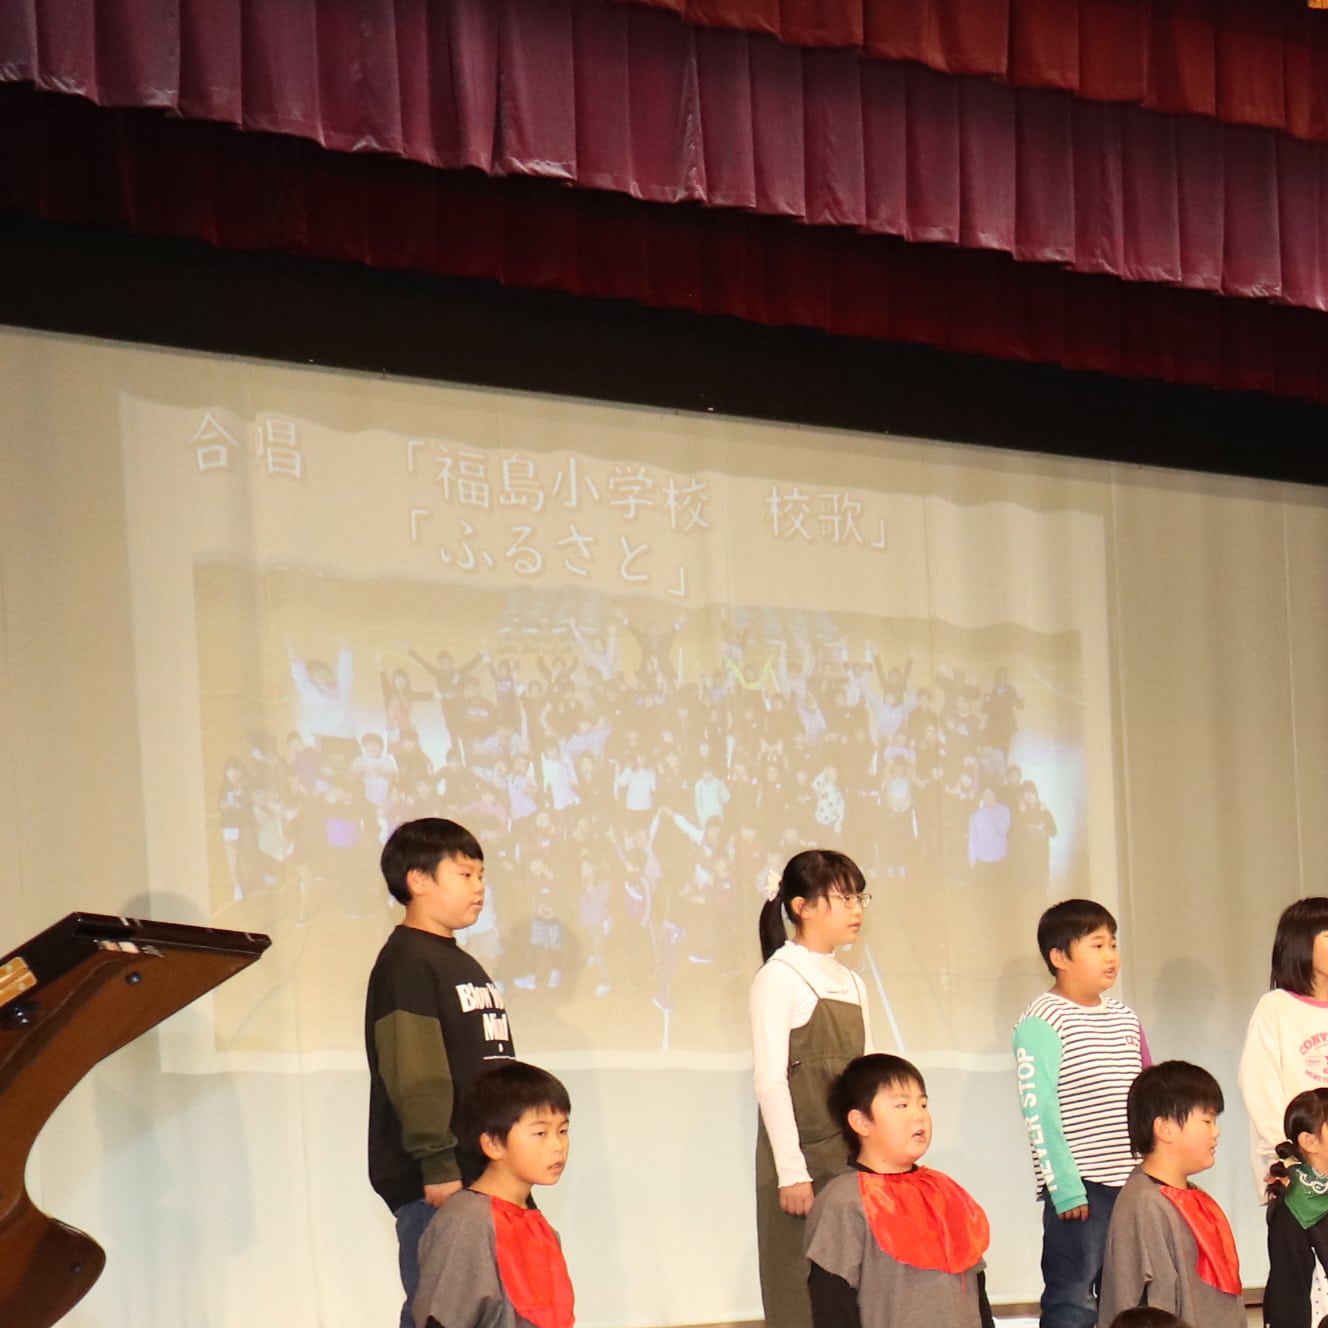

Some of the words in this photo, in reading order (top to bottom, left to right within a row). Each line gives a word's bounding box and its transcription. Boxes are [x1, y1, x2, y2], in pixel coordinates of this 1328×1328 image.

[188, 411, 302, 478] 合唱
[407, 440, 709, 531] 「福島小学校
[766, 485, 887, 549] 校歌」
[410, 508, 687, 597] 「ふるさと」
